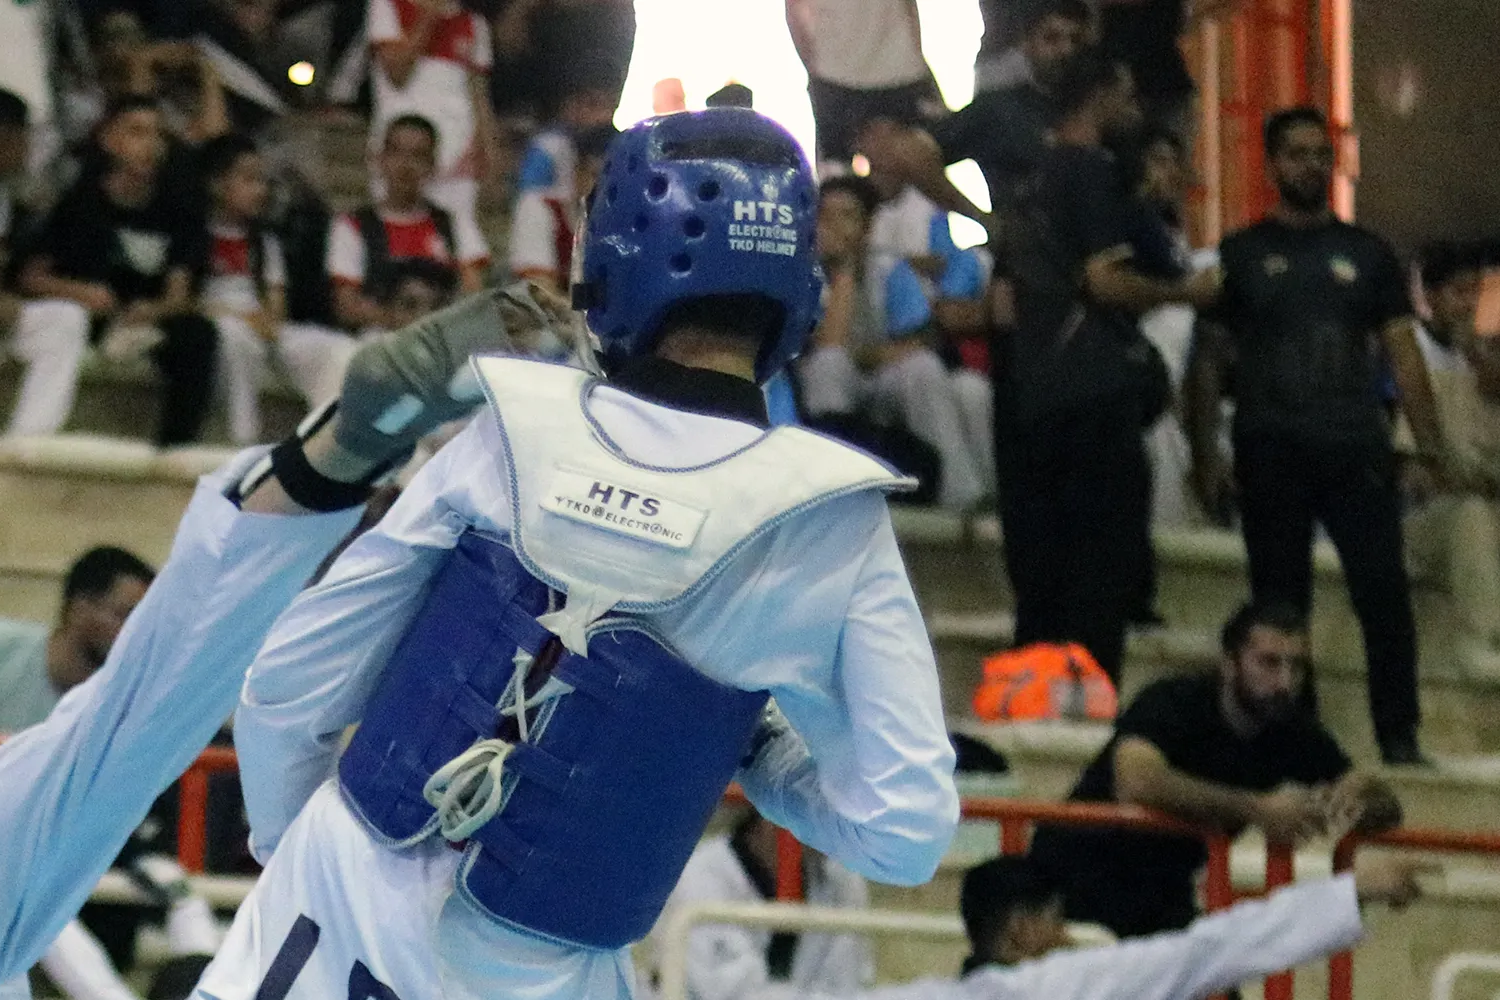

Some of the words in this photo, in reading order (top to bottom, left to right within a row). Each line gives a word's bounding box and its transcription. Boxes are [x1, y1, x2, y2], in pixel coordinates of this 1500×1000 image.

[734, 200, 794, 225] HTS
[729, 239, 755, 251] TKD
[756, 241, 796, 257] HELMET
[587, 481, 661, 517] HTS
